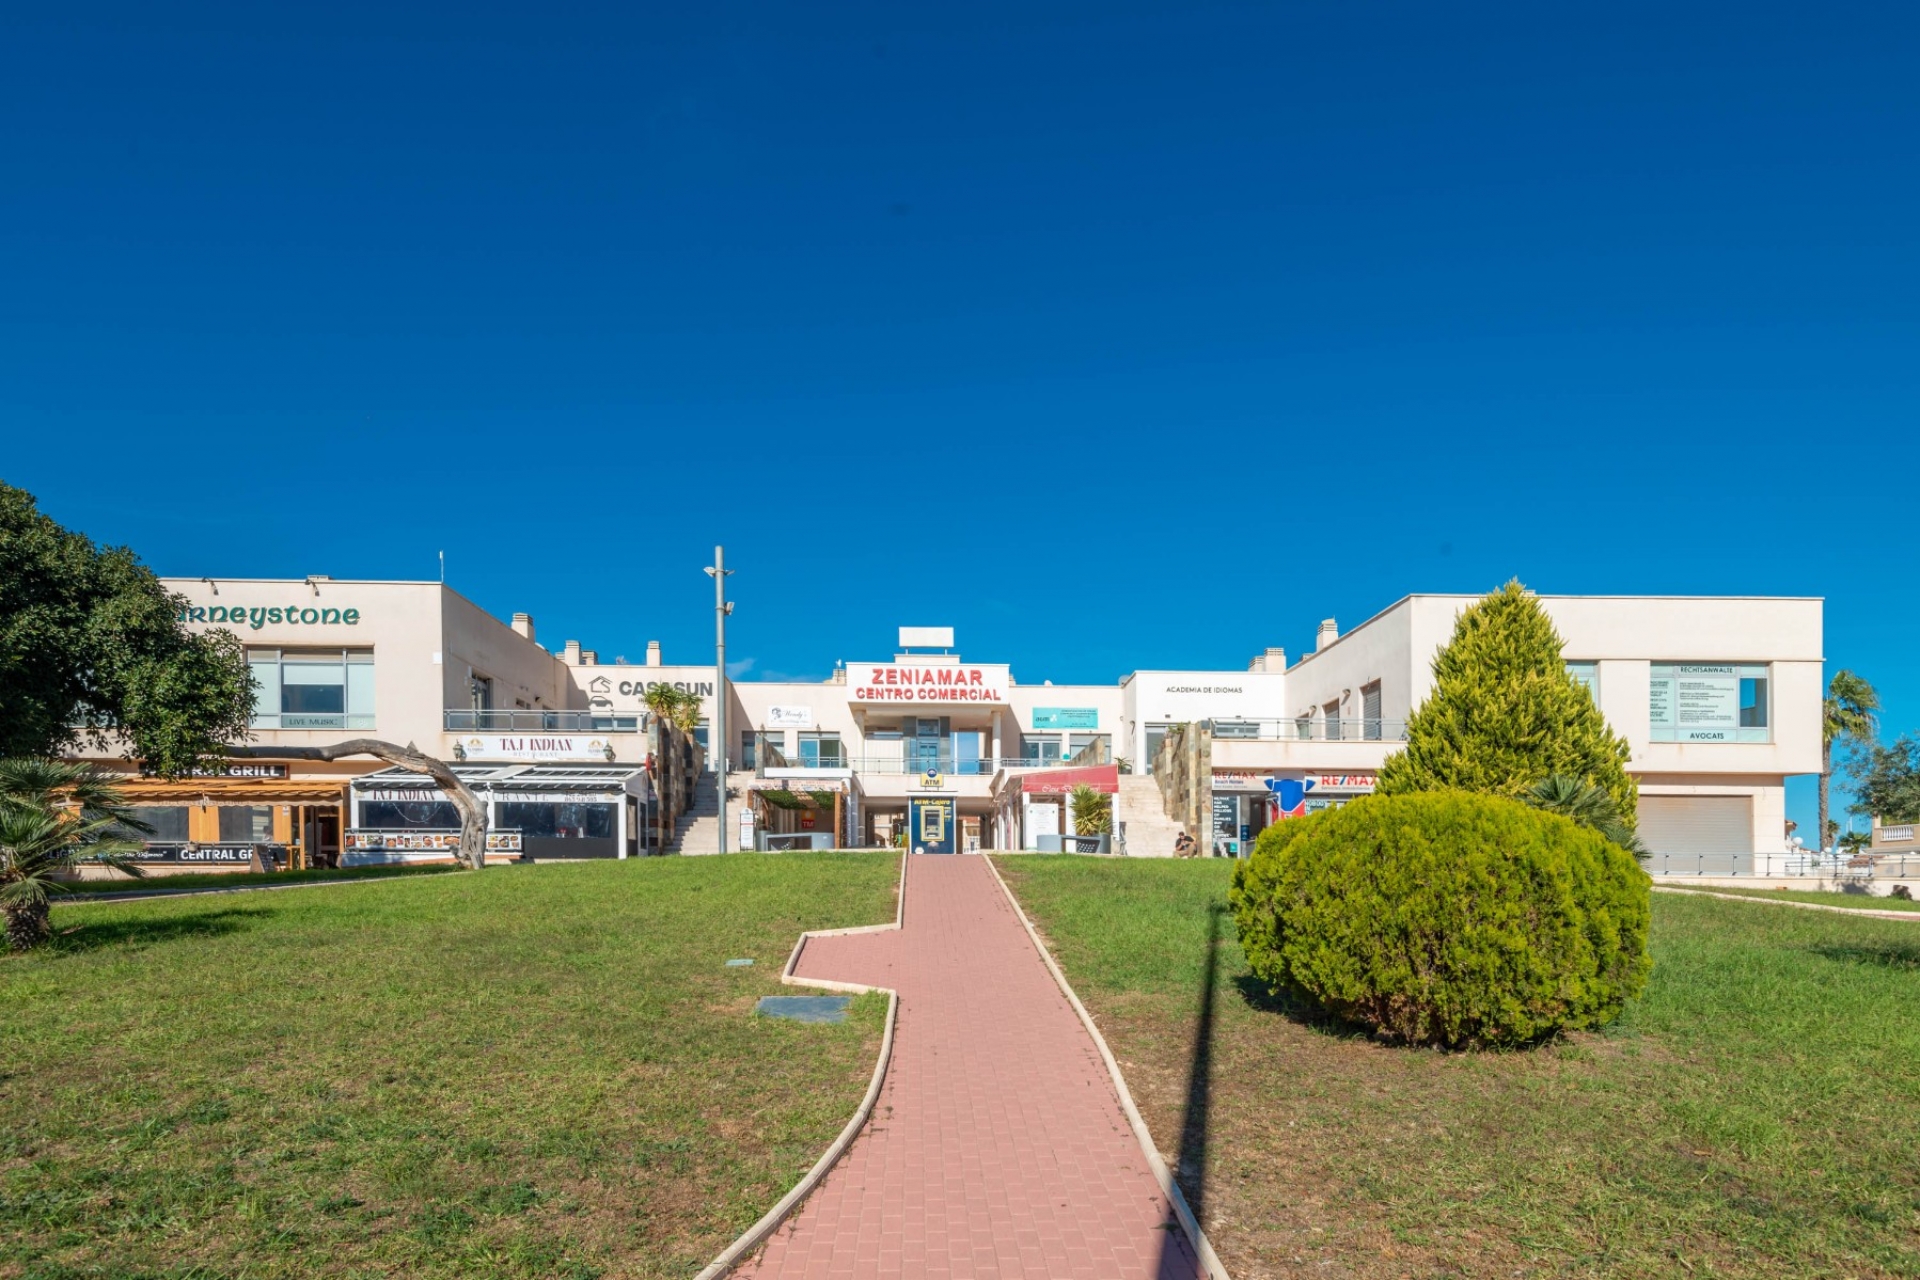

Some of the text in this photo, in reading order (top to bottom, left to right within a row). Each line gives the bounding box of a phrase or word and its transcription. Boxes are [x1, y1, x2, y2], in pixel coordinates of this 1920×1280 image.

[871, 668, 983, 686] ZENIAMAR
[618, 681, 713, 697] CASSUN
[856, 687, 1002, 701] CENTRO COMERCIAL
[289, 718, 306, 726] LIVE
[1689, 732, 1725, 740] AVOCATS
[500, 738, 573, 751] TAJ INDIAN
[229, 764, 280, 777] GRILL
[1213, 771, 1257, 780] RE/MAX
[1321, 774, 1378, 786] RE/MAX
